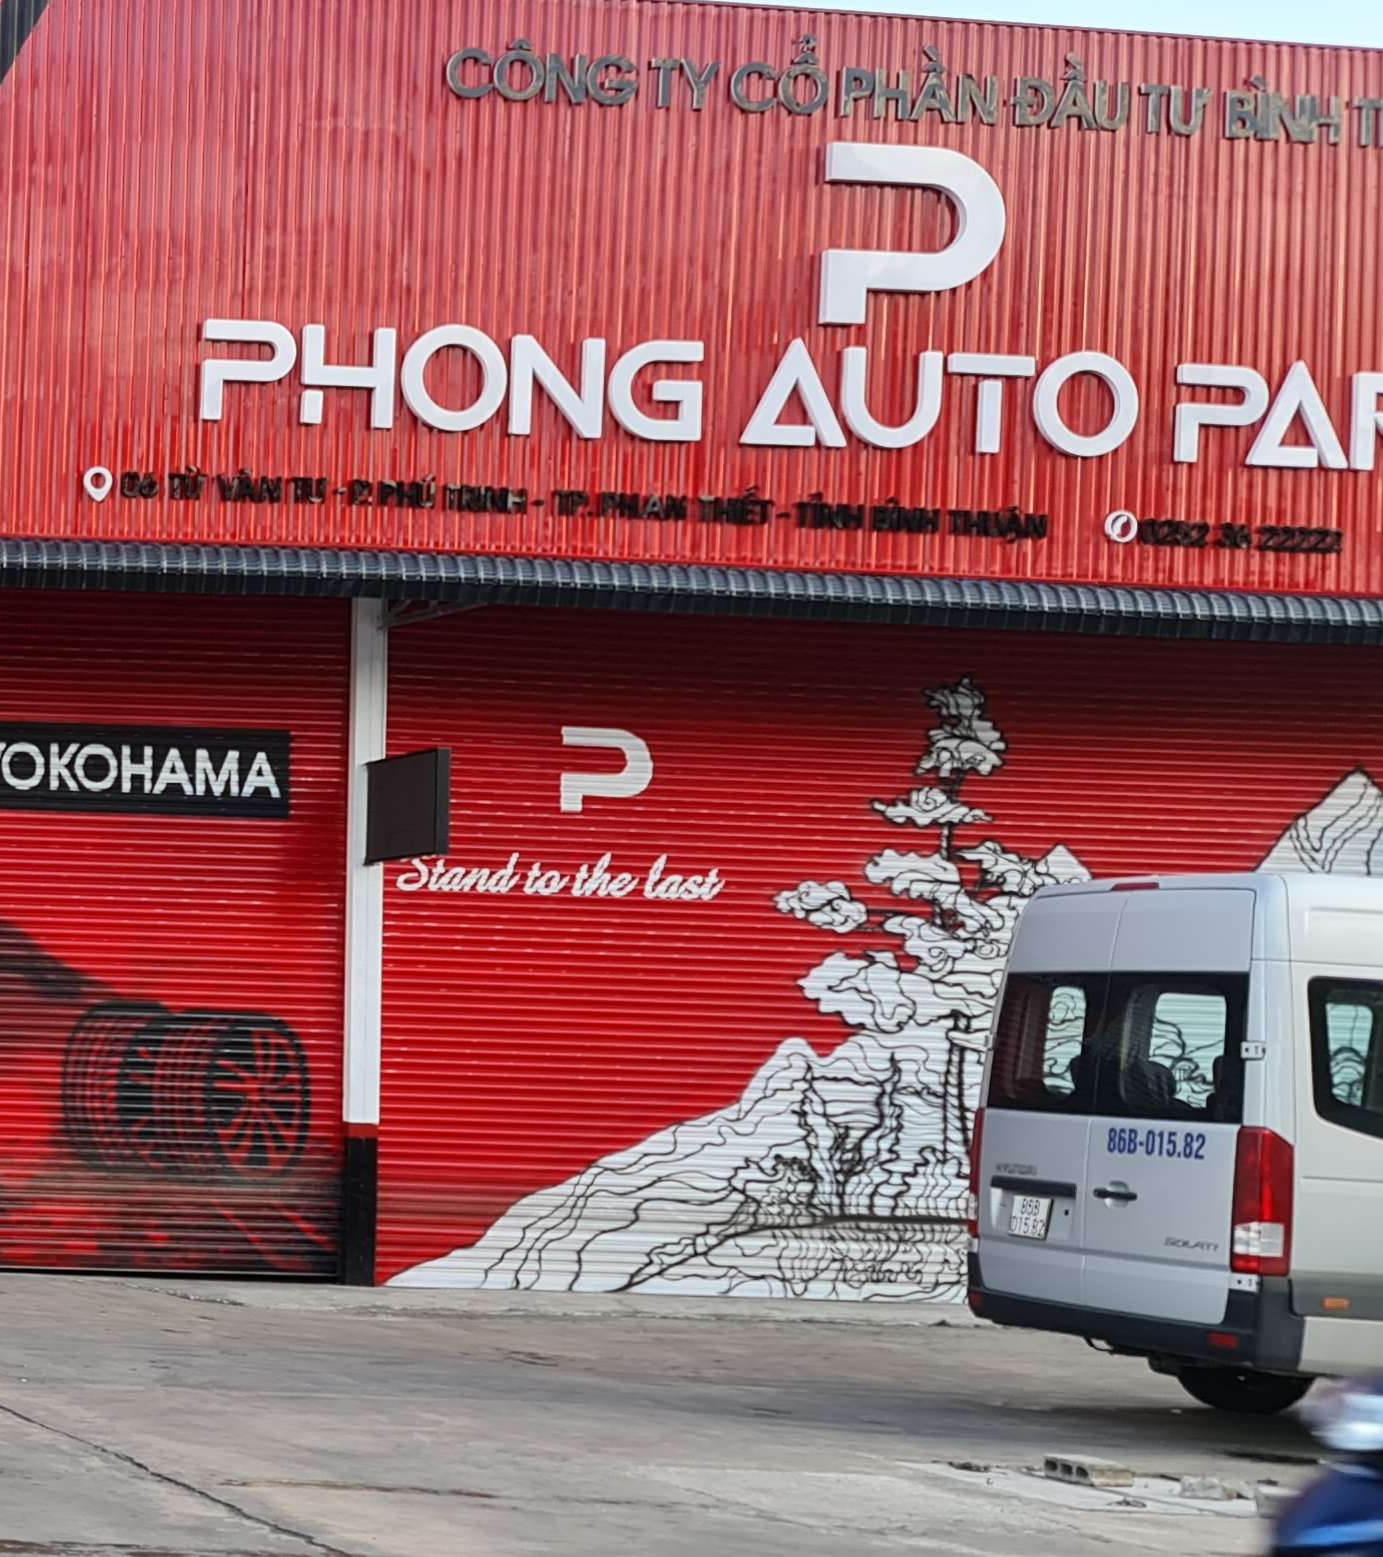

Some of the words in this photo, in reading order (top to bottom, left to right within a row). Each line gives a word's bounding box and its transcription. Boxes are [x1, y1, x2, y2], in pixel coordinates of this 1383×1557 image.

[446, 38, 638, 107] CÔNG
[649, 57, 721, 112] TY
[730, 32, 829, 115] CỔ
[839, 44, 999, 125] PHẦN
[1009, 52, 1130, 132] ĐẦU
[1139, 83, 1213, 137] TƯ
[1224, 74, 1342, 146] BÌNH
[1351, 96, 1383, 148] T
[819, 142, 1006, 324] P
[199, 318, 706, 443] PHONG
[739, 338, 1139, 458] AUTO
[560, 726, 654, 812] P
[396, 852, 521, 893] Stand
[523, 862, 570, 896] to
[571, 851, 639, 897] the
[643, 853, 726, 900] last
[1107, 1127, 1206, 1160] 86B-015.82
